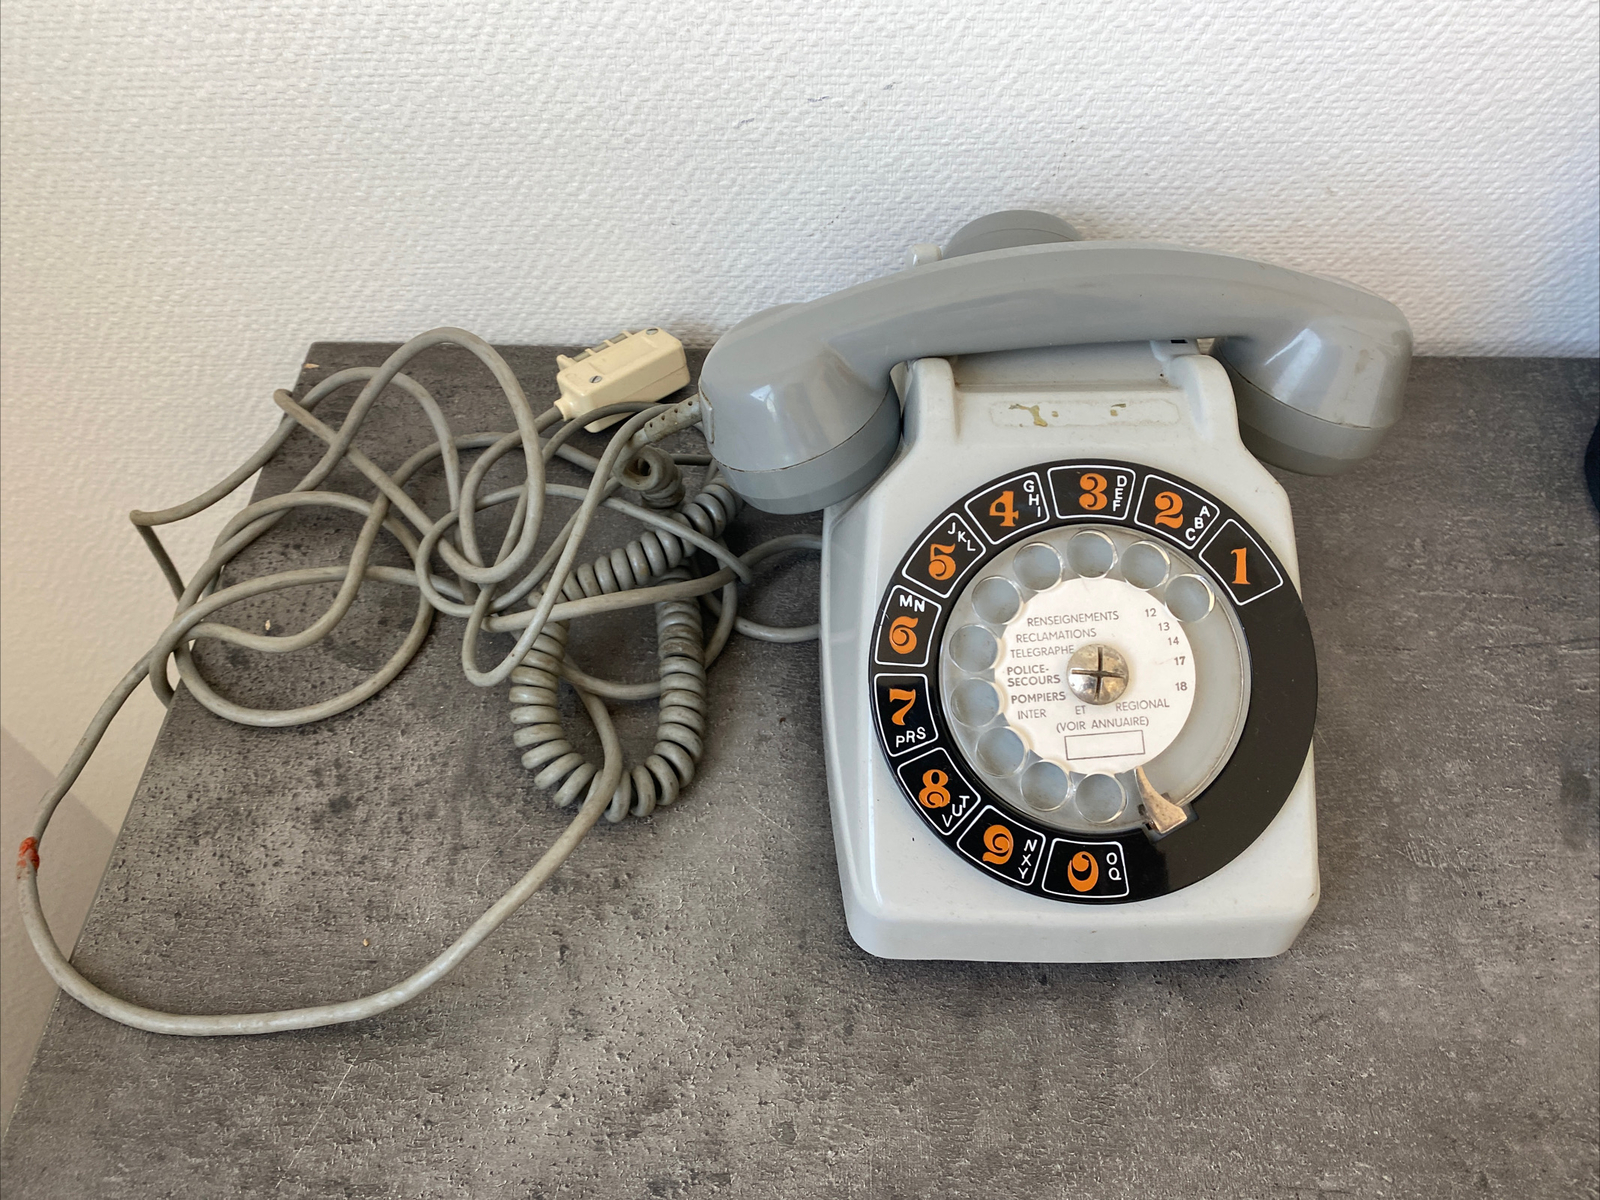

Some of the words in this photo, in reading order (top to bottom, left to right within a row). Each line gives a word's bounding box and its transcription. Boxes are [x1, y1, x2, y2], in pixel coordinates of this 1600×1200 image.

[989, 490, 1019, 527] 4
[1079, 473, 1107, 511] 3
[1154, 491, 1184, 529] 2
[928, 543, 957, 581] 5
[1231, 547, 1250, 585] 1
[888, 615, 919, 655] 6
[1016, 627, 1097, 643] RECLAMATIONS
[1158, 621, 1170, 632] 13
[1027, 610, 1120, 627] RENSEIGNEMENTS
[1145, 607, 1157, 618] 12
[1006, 664, 1049, 676] POLICE-
[1174, 656, 1186, 666] 17
[1010, 645, 1075, 659] TELEGRAPHE
[1168, 636, 1180, 646] 14
[1007, 675, 1061, 687] SECOURS
[1011, 691, 1066, 704] POMPIERS
[1175, 681, 1188, 691] 18
[889, 688, 917, 726] 7
[1017, 708, 1047, 720] INTER
[1075, 705, 1086, 715] ET
[1115, 698, 1170, 712] REGIONAL
[1056, 721, 1086, 734] (VOIR
[1091, 716, 1150, 729] ANNUAIRE)
[918, 769, 951, 809] 8
[983, 824, 1014, 865] 9
[1067, 851, 1099, 892] 0
